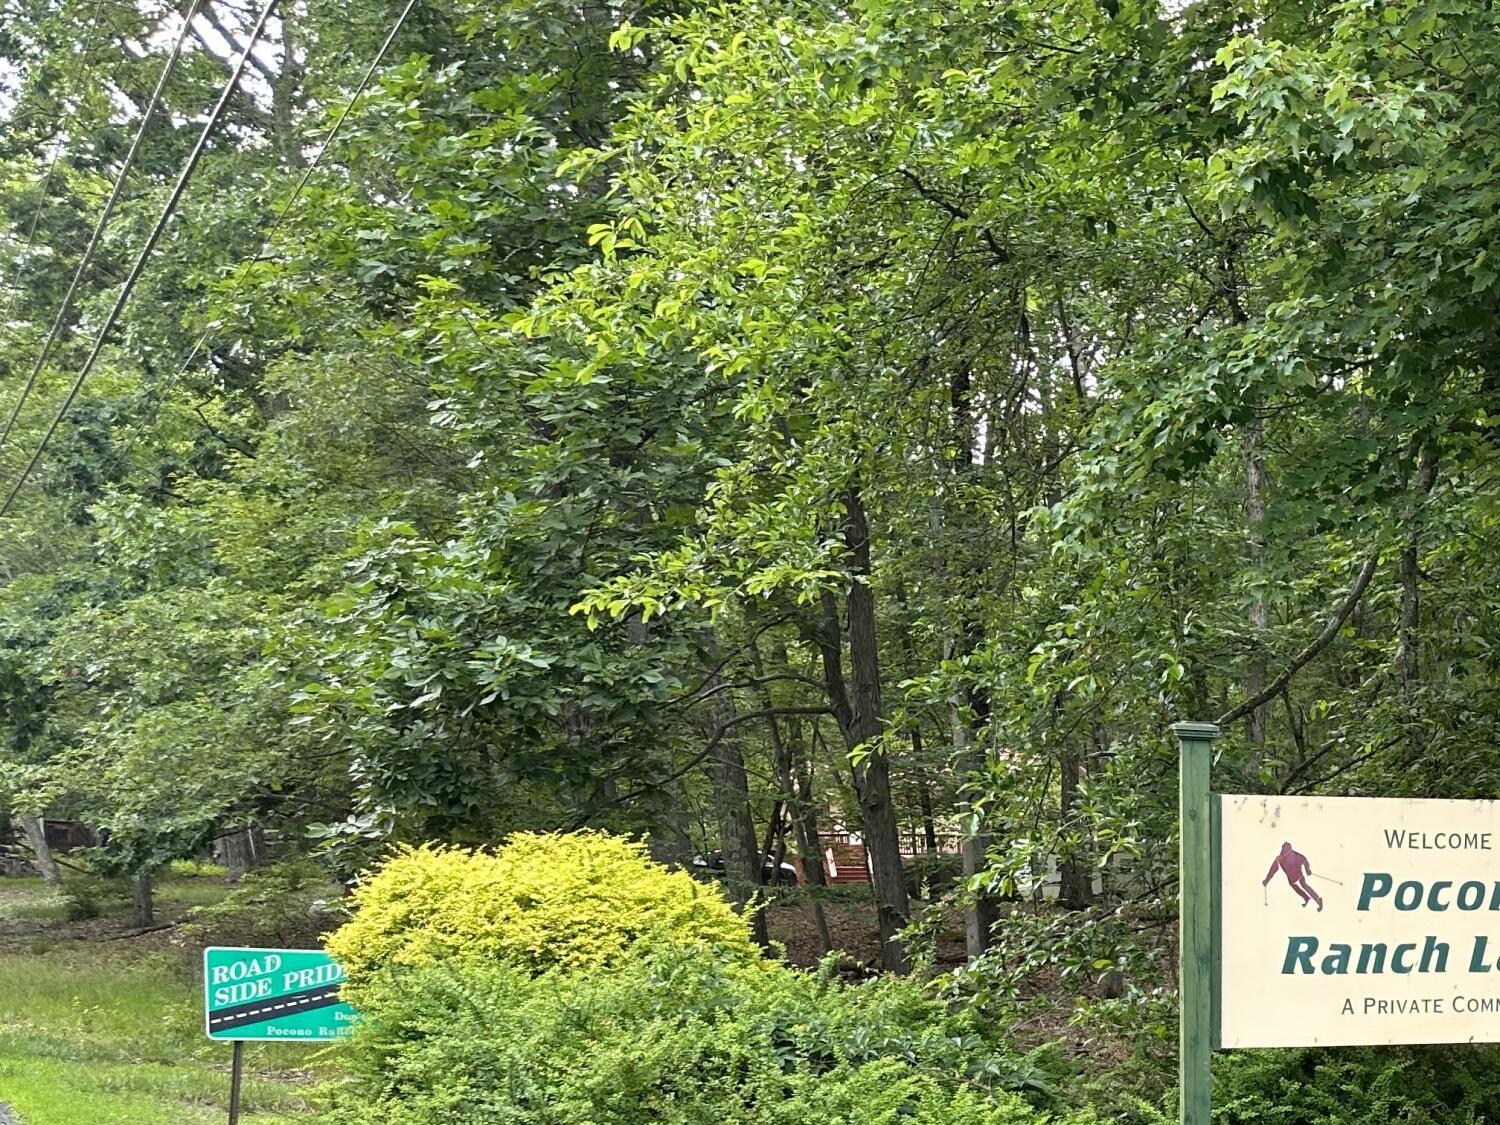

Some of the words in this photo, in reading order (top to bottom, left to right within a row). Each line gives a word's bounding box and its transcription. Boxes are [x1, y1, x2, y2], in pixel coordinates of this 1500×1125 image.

[1281, 936, 1450, 975] Ranch
[211, 955, 281, 985] ROAD
[214, 978, 272, 1006] SIDE
[1341, 999, 1354, 1015] A
[267, 1026, 312, 1036] Pocono
